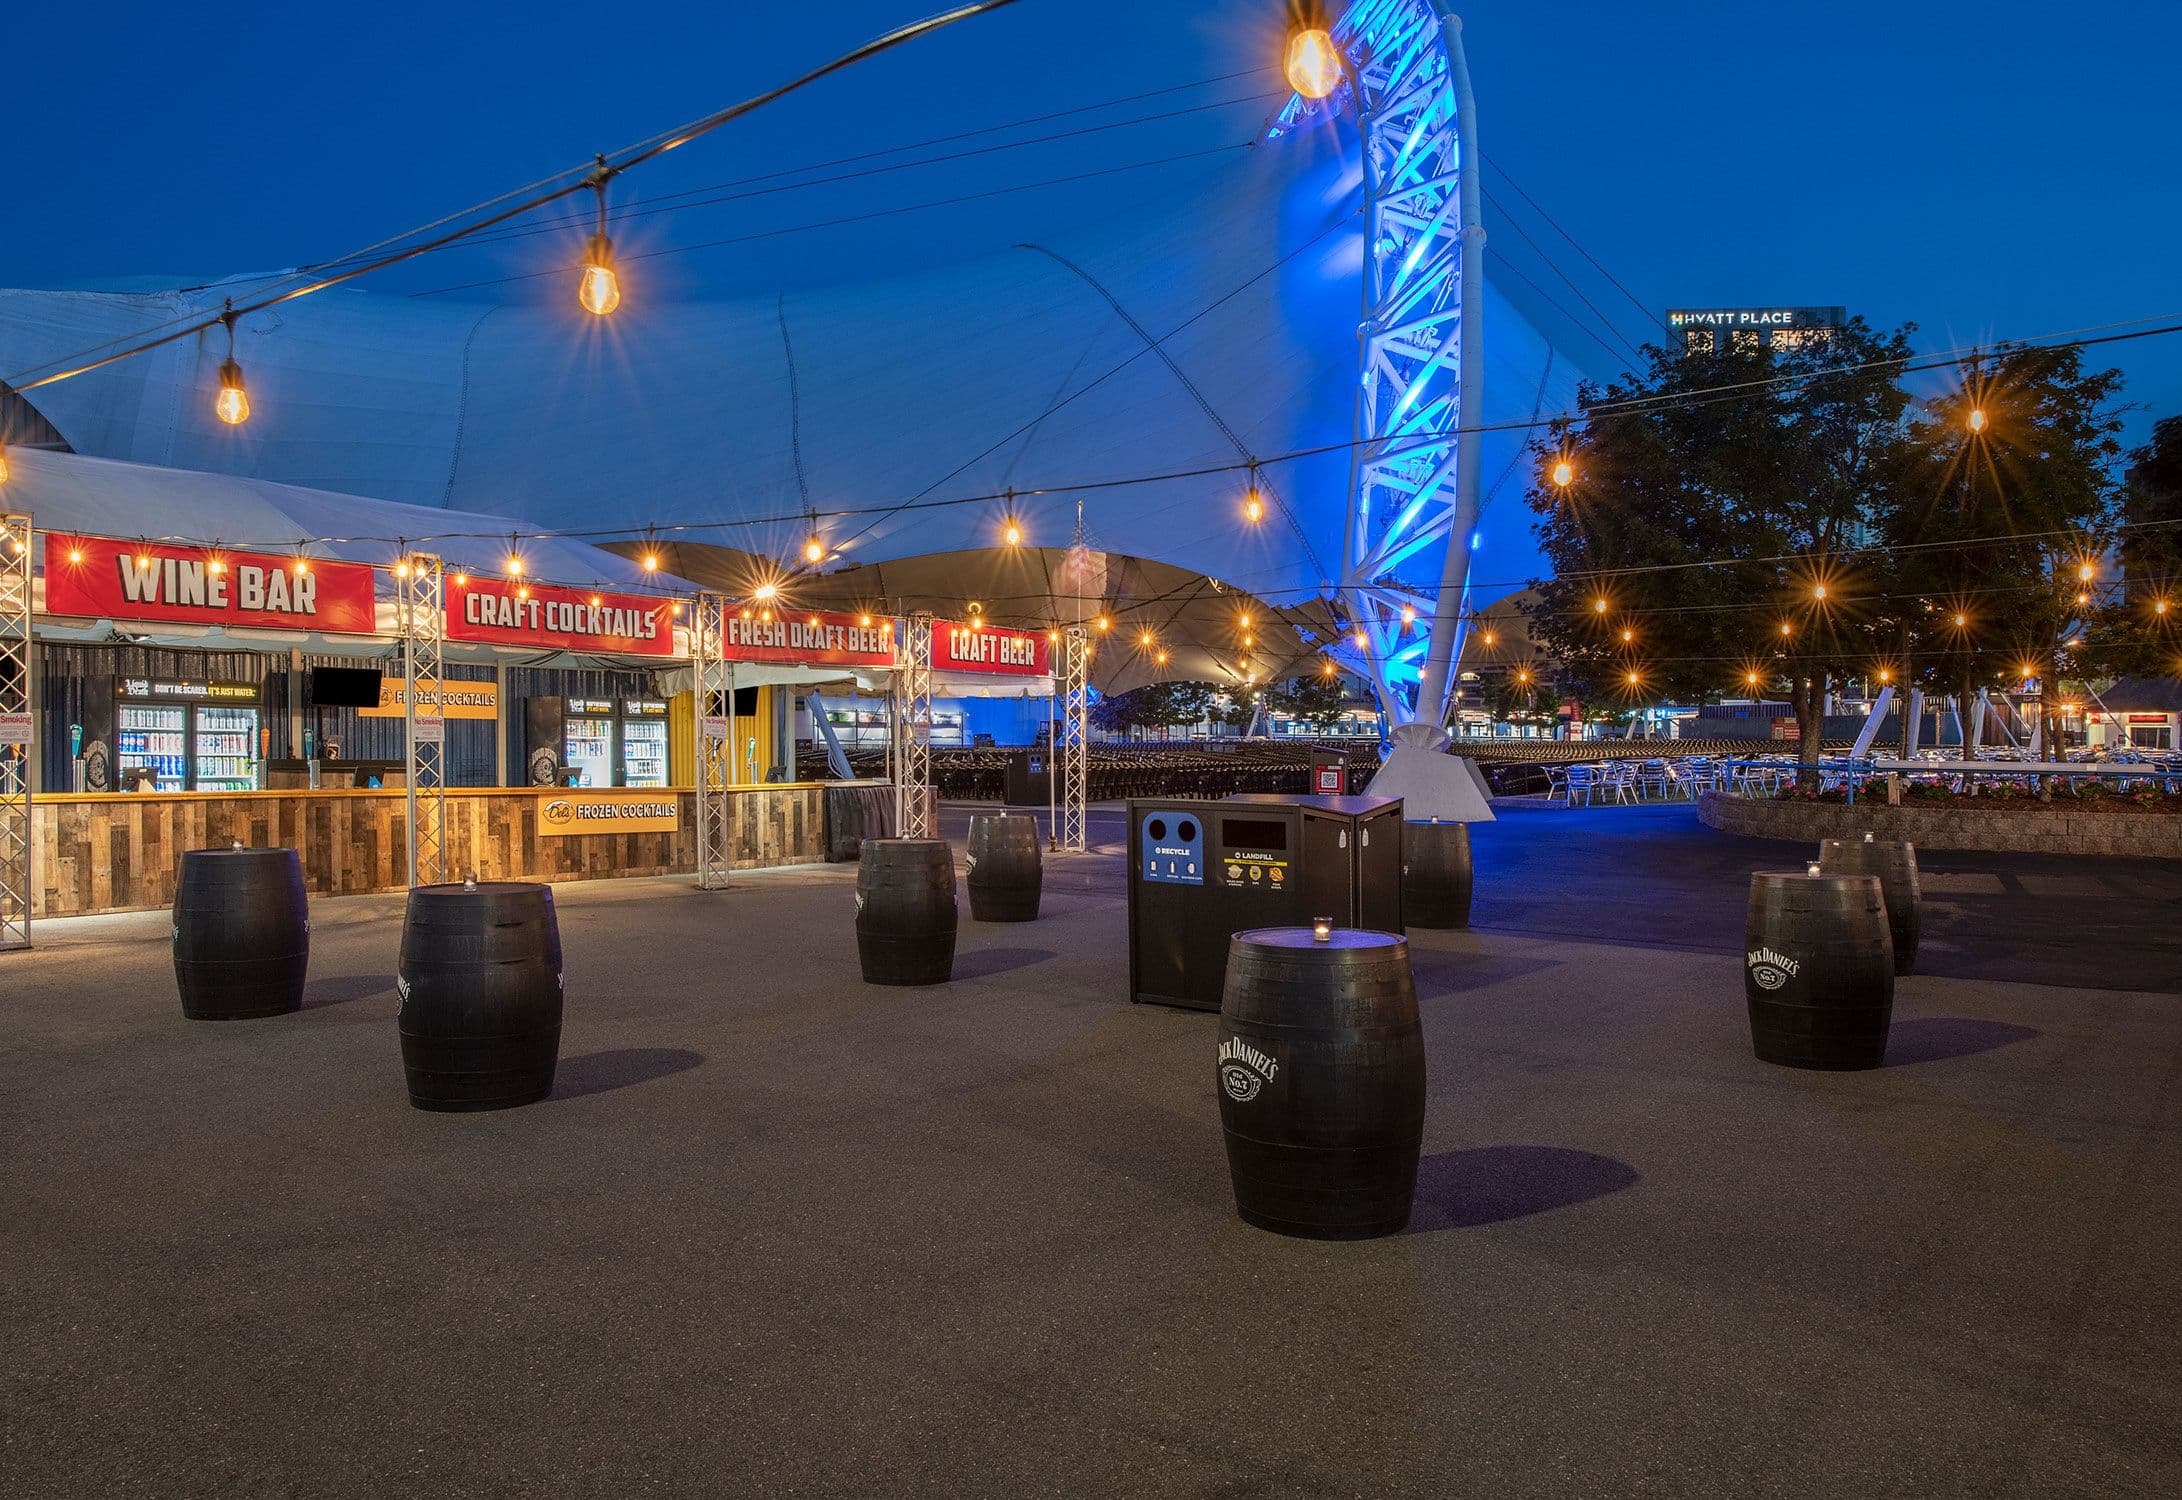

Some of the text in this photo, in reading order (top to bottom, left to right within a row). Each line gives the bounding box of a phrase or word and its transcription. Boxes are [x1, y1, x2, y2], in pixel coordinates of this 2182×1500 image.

[1685, 313, 1734, 324] HYATT
[1741, 312, 1792, 324] PLACE
[117, 554, 317, 614] WINE BAR
[466, 592, 657, 640] CRAFT COCKTAILS
[728, 618, 888, 653] FRESH DRAFT BEER
[950, 630, 1034, 666] CRAFT BEER
[220, 687, 233, 697] JUST
[396, 691, 496, 706] FOZEN COCKTAILS
[0, 714, 32, 725] Smoking
[421, 719, 443, 727] Smoking
[577, 804, 619, 819] FROZEN
[620, 803, 676, 818] COCKTAILS
[1161, 847, 1190, 856] RECYCLE
[1242, 852, 1273, 861] LANDFILL
